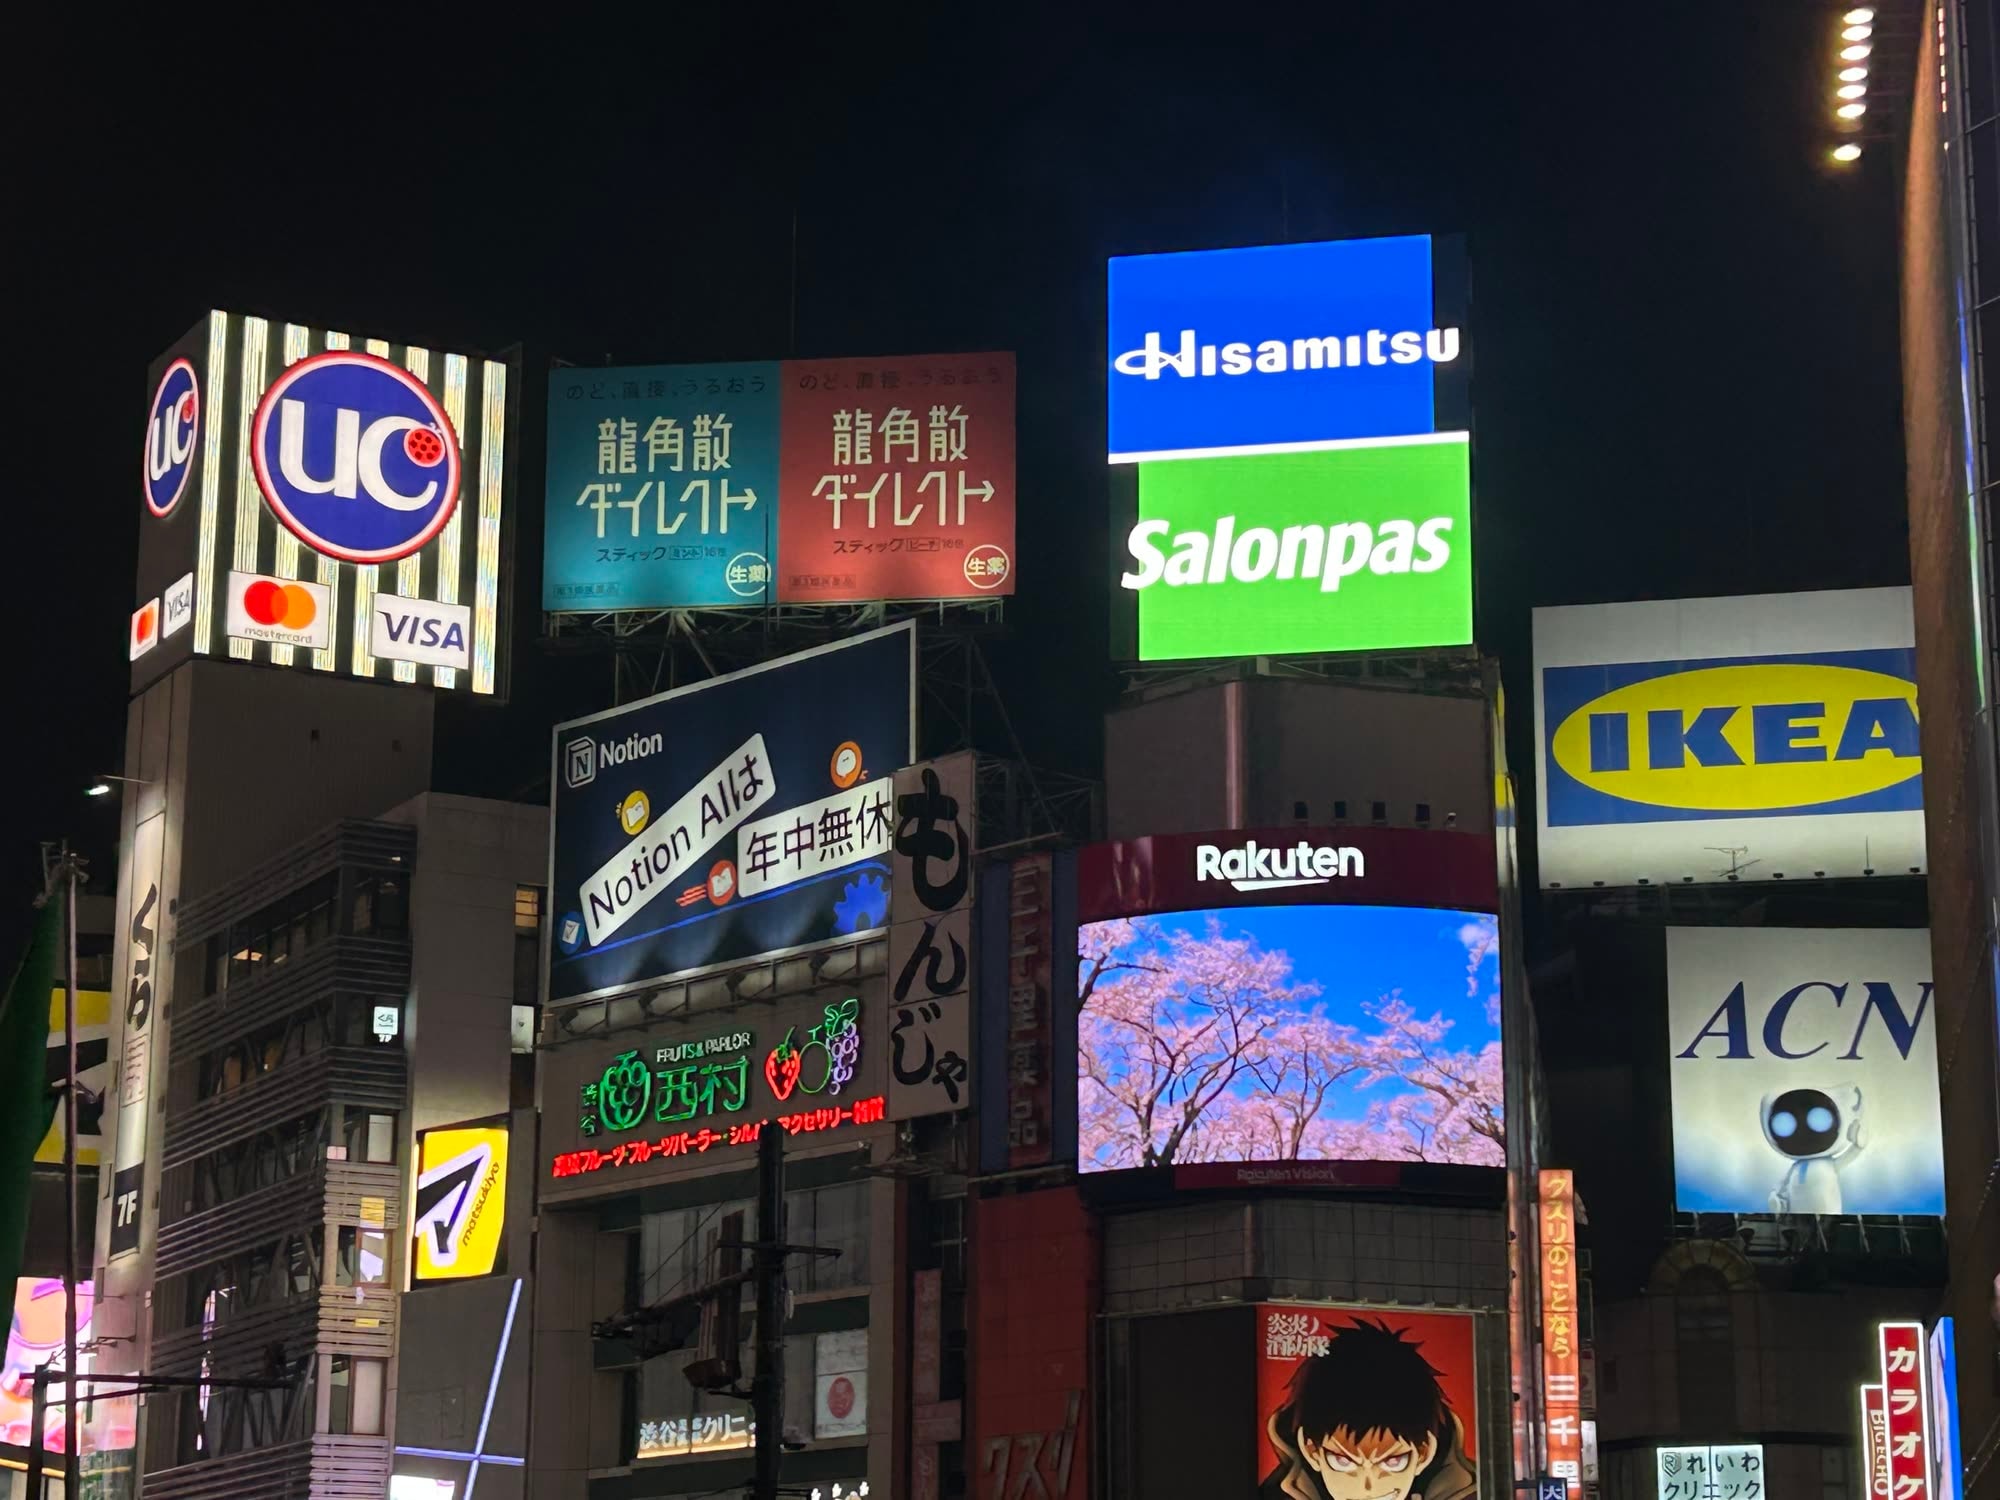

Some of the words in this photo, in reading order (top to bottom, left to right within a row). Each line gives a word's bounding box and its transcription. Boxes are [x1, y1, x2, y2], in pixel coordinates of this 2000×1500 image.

[1114, 328, 1461, 380] Hisamitsu
[598, 413, 733, 475] 龍角散
[833, 404, 969, 466] 龍角散
[576, 477, 758, 538] ダイレクト
[812, 470, 995, 530] ダイレクト
[1120, 514, 1454, 592] Salonpas
[376, 610, 465, 652] VISA
[600, 731, 662, 769] Notion
[1589, 697, 1920, 773] IKEA
[745, 791, 893, 881] 年中無休
[1197, 840, 1364, 884] Rakuten
[589, 823, 691, 930] Notion
[891, 768, 969, 1104] もんじゃ
[1675, 980, 1934, 1061] ACN
[655, 1056, 749, 1122] 西村
[117, 1189, 137, 1228] 7F
[1546, 1178, 1571, 1359] クスリのことなら
[1870, 1409, 1887, 1442] BIG
[1888, 1346, 1925, 1500] カラオケ
[1687, 1452, 1761, 1475] れいわ
[1874, 1446, 1889, 1496] ECHO
